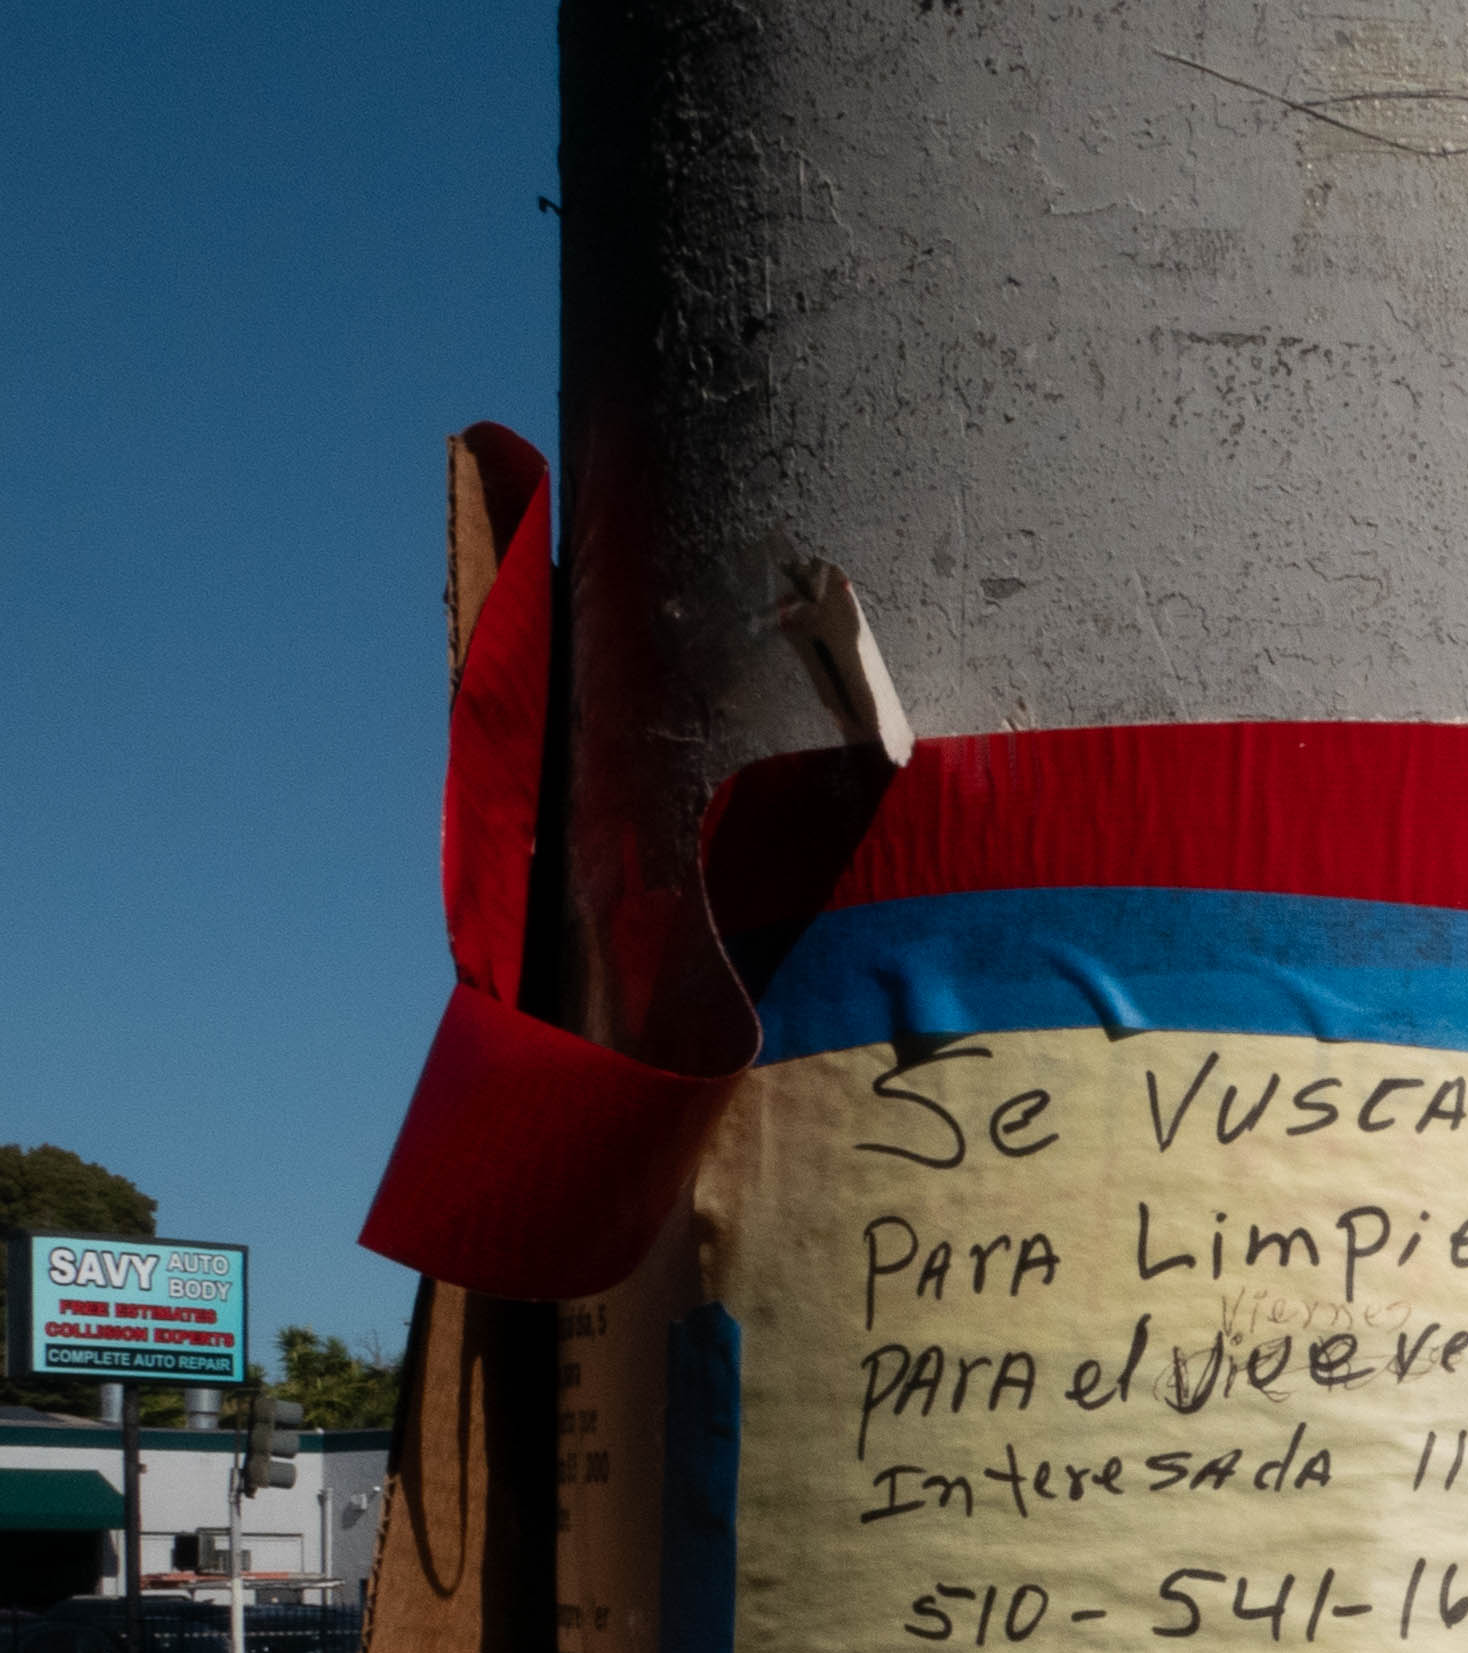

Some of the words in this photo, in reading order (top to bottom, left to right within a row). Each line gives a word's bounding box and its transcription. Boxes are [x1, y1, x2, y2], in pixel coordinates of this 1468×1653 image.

[853, 1047, 1059, 1170] Se
[49, 1246, 160, 1291] SAVY
[166, 1252, 229, 1275] AUTO
[168, 1277, 232, 1302] BODY
[45, 1321, 148, 1341] COLLISION
[49, 1350, 131, 1366] COMPLETE
[134, 1353, 176, 1369] AUTO
[179, 1356, 231, 1371] REPAIR
